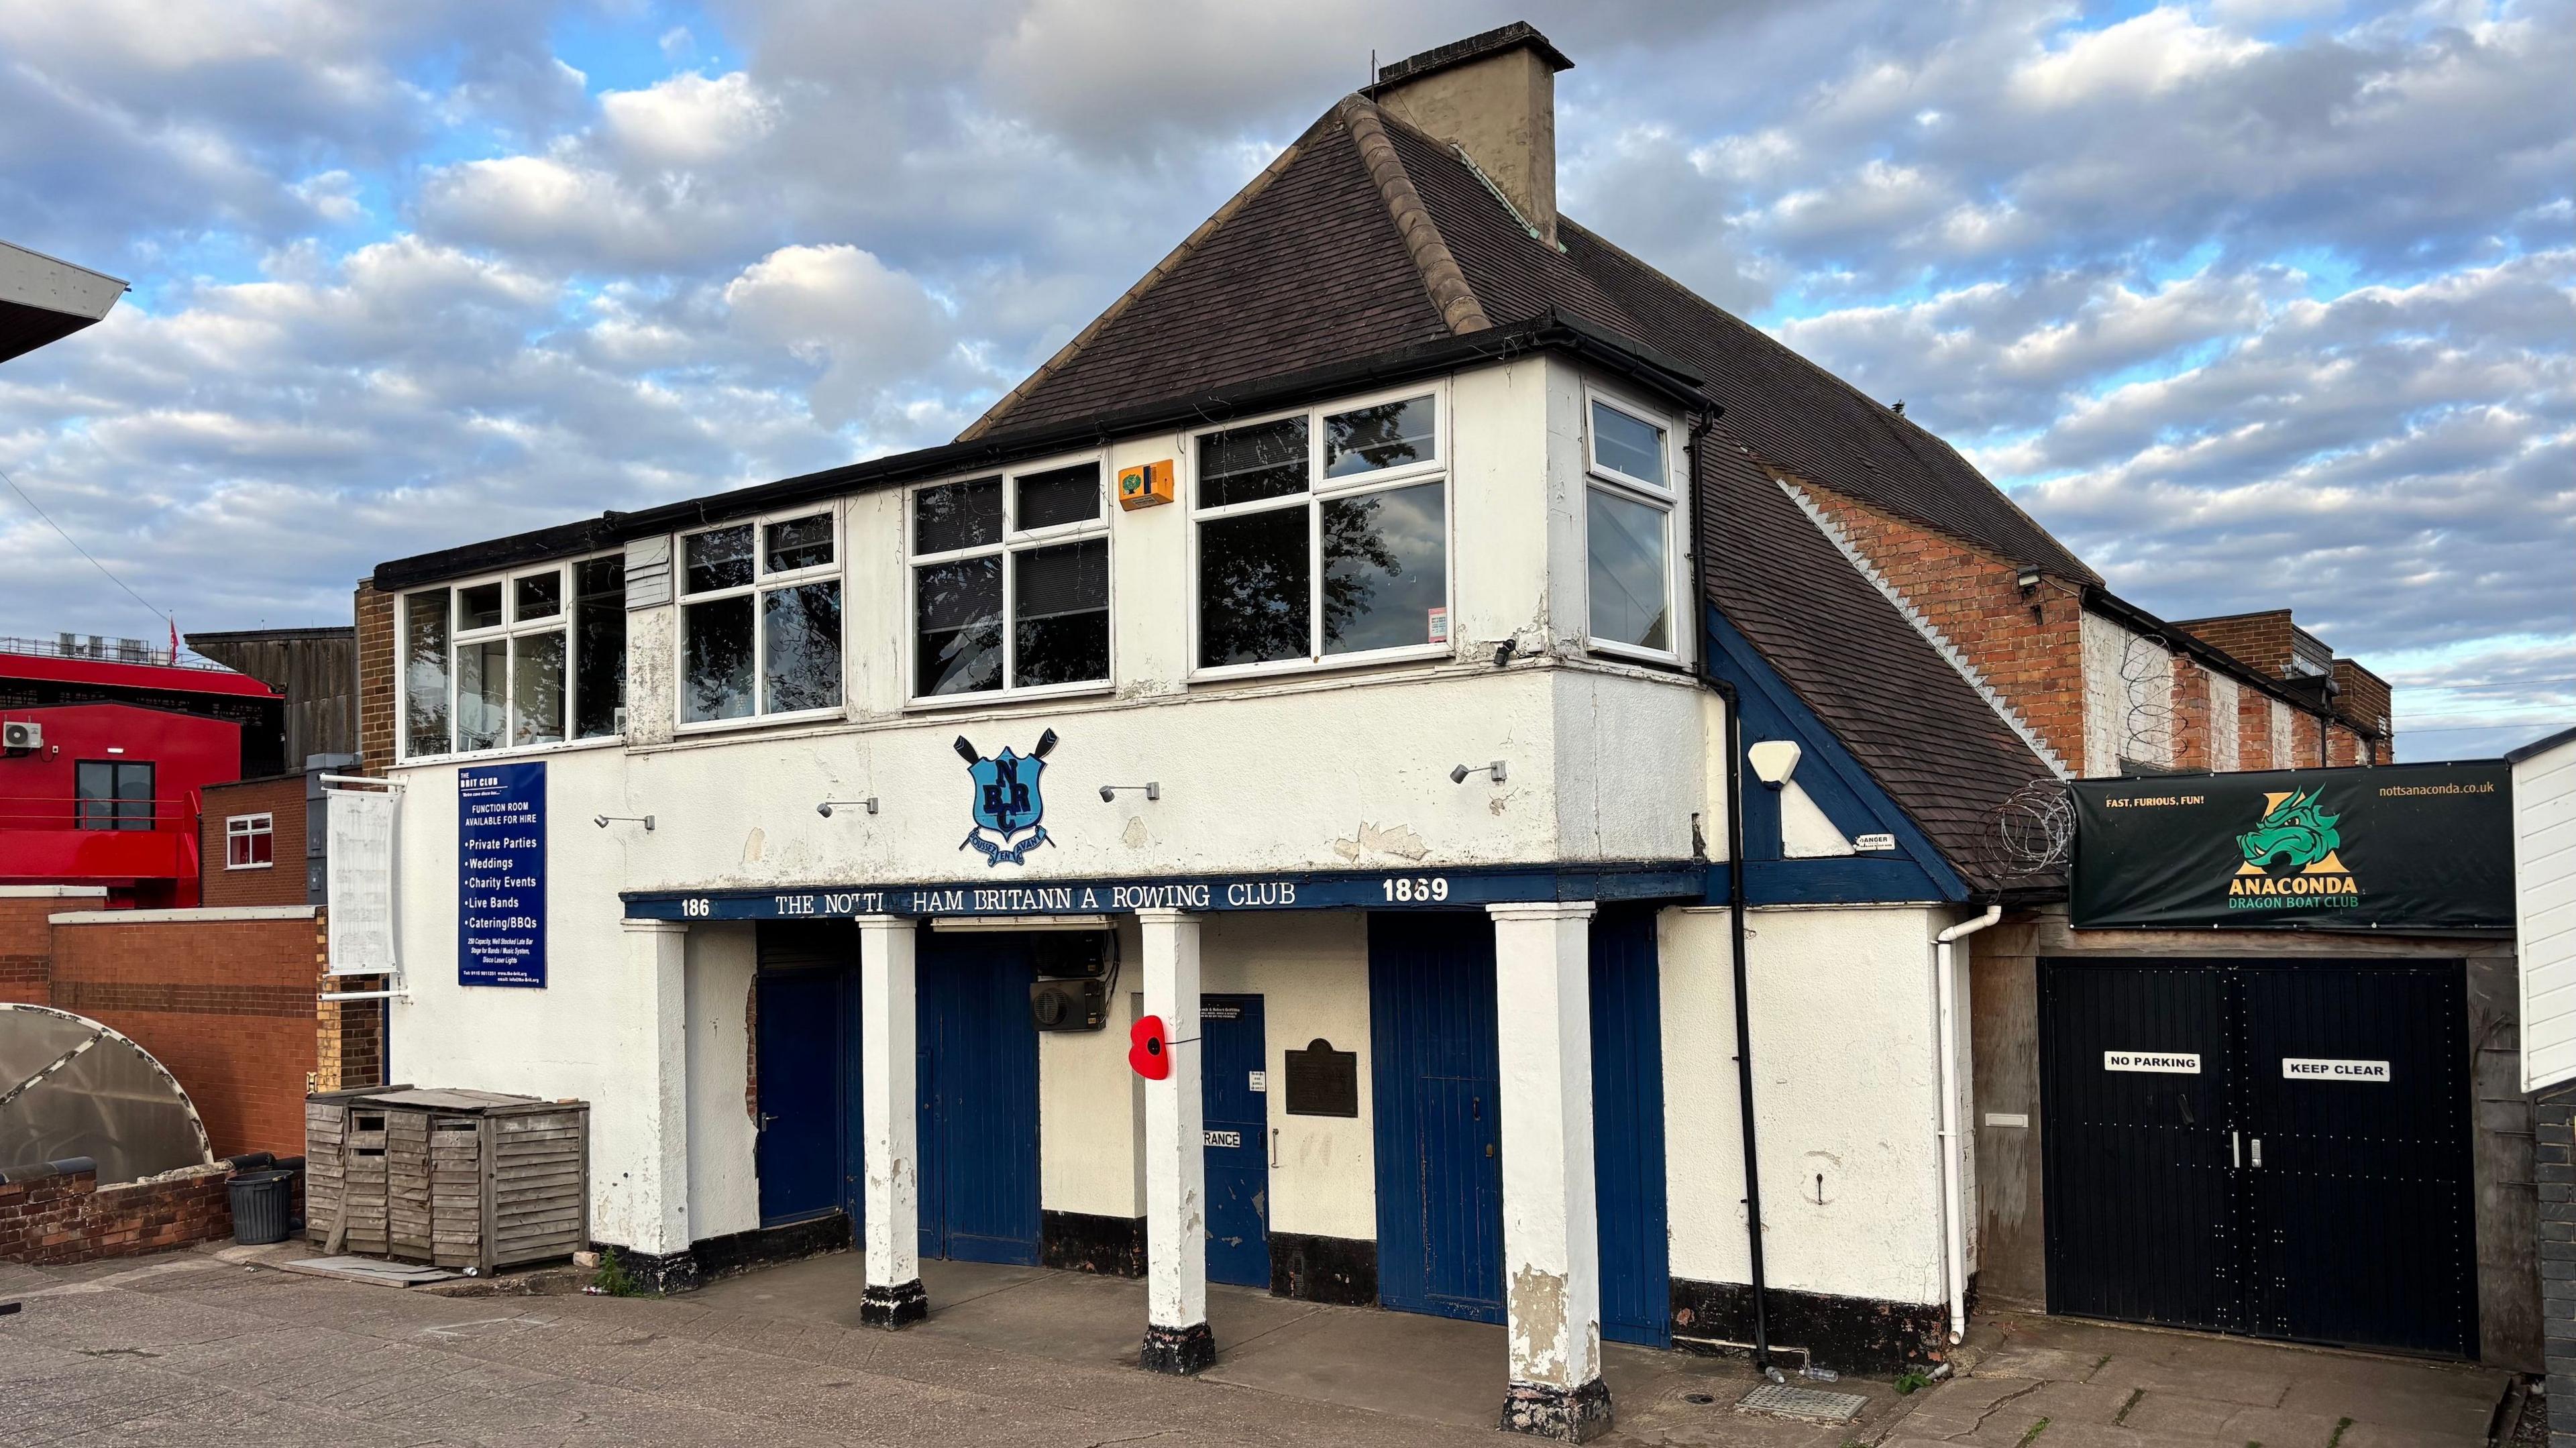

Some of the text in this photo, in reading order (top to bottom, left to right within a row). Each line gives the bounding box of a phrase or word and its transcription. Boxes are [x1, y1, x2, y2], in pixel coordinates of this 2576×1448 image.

[460, 777, 498, 788] BRIT CLUB
[2379, 781, 2495, 797] nottsanaconda.co.uk
[472, 801, 529, 814] FUNCTION ROOM
[2106, 795, 2204, 807] FAST, FURIOUS, FUN!
[465, 814, 537, 826] AVAILABLE FOR HIRE
[469, 836, 537, 850] Private Parties
[469, 858, 513, 871] Weddings
[469, 876, 536, 891] Charity Events
[2229, 877, 2359, 895] ANACONDA
[469, 896, 519, 908] Live Bands
[775, 895, 814, 915] THE
[1112, 885, 1210, 908] ROWING
[1228, 882, 1296, 905] CLUB
[1383, 877, 1448, 901] 1869
[2229, 895, 2359, 909] DRAGON BOAT CLUB
[469, 916, 537, 931] Catering/BBQs
[471, 947, 481, 955] Stage
[505, 957, 518, 965] Lights
[2110, 1056, 2196, 1068] NO PARKING
[2291, 1064, 2385, 1075] KEEP CLEAR
[1203, 1132, 1240, 1146] RANCE
